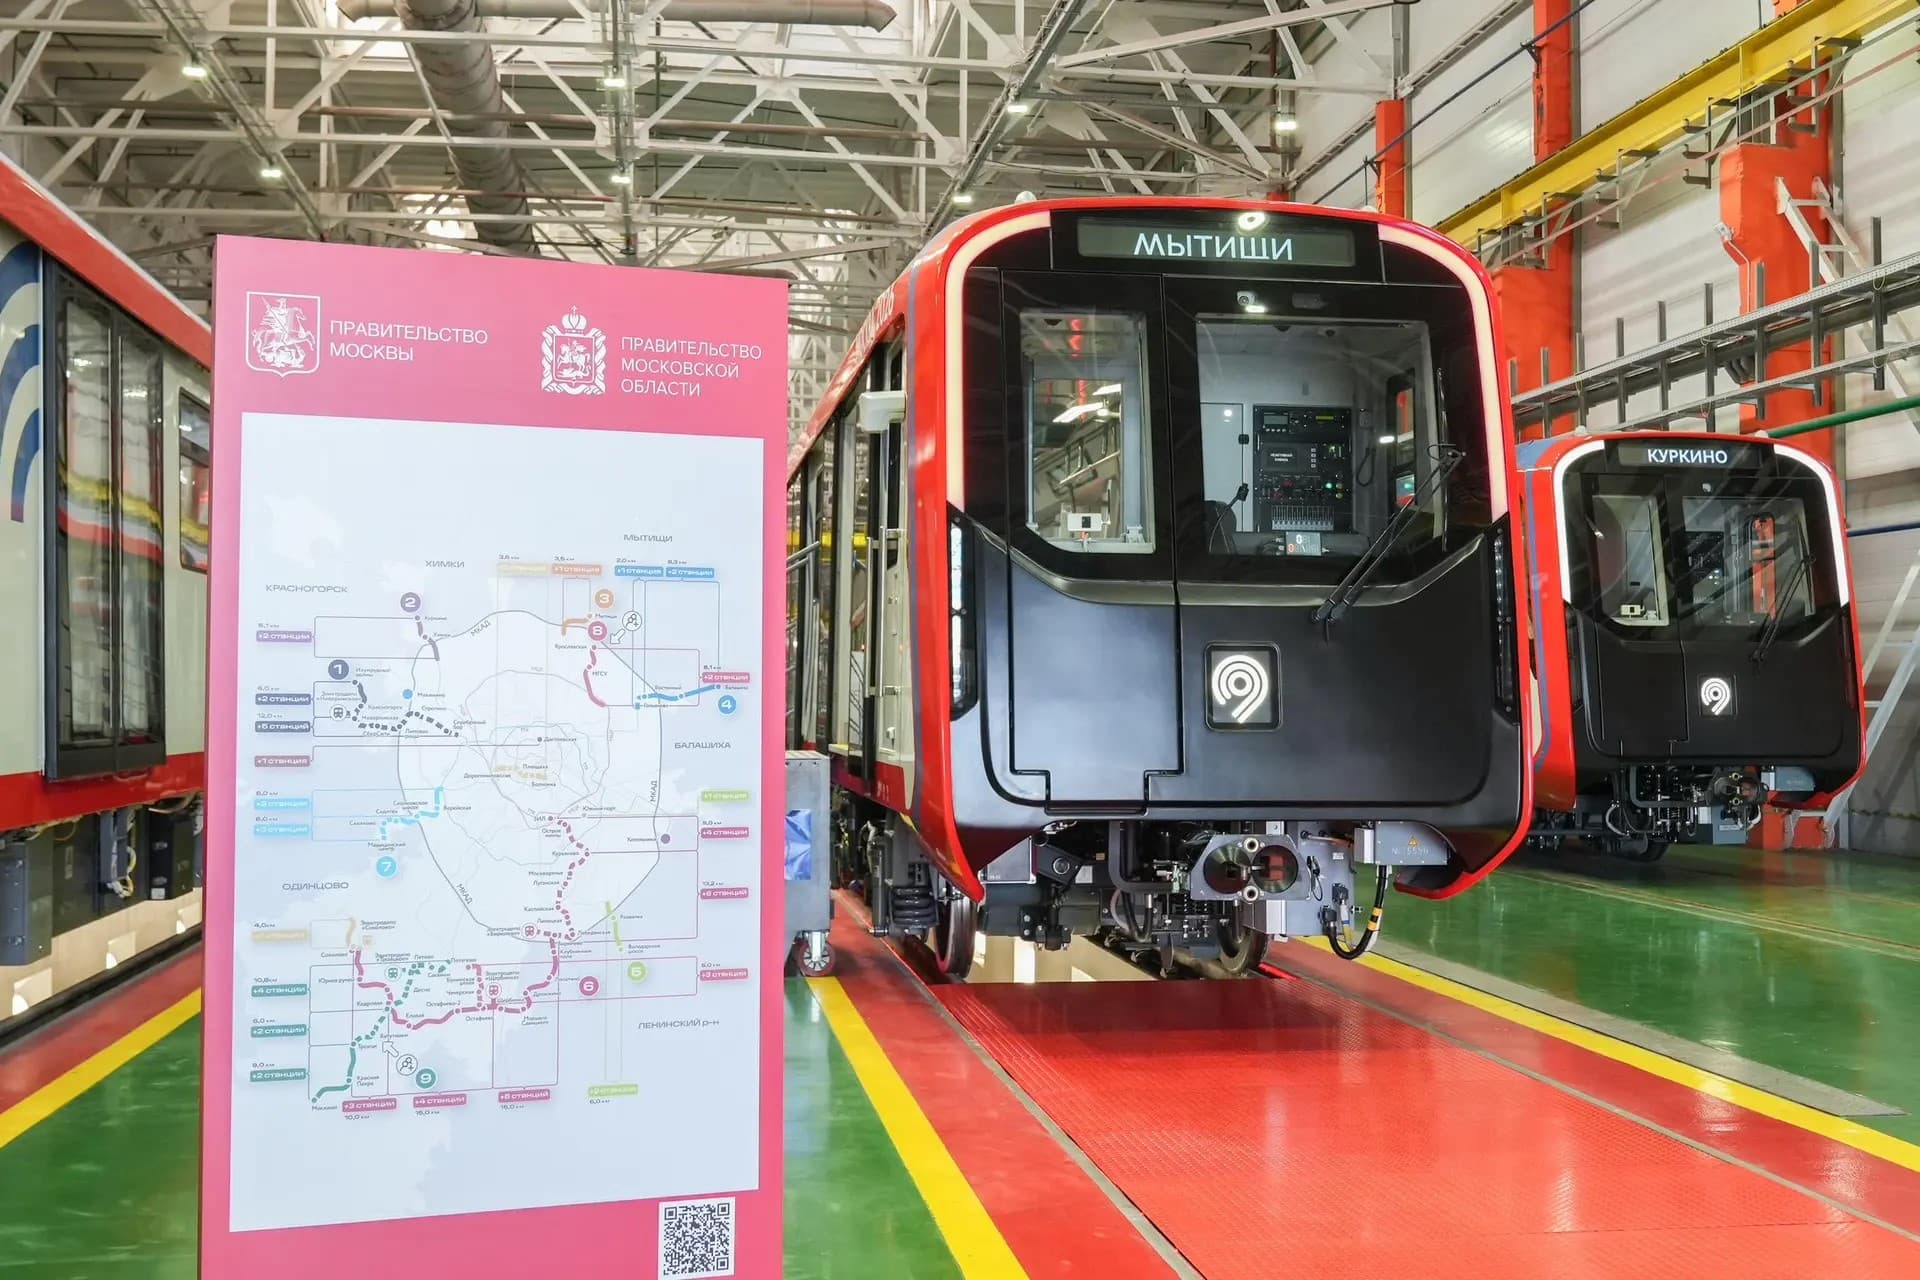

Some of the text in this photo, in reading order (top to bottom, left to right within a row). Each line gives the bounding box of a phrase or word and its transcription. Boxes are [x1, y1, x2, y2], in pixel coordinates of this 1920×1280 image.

[329, 320, 489, 344] ПРАВИТЕЛЬСТВО
[329, 342, 414, 361] МОСКВЫ
[621, 337, 762, 360] ПРАВИТЕЛЬСТВО
[621, 357, 740, 378] МОСКОВСКОЙ
[621, 378, 701, 397] ОБЛАСТИ
[1647, 448, 1728, 464] КУРКИНО
[623, 534, 673, 543] МЫТИЩИ
[425, 560, 465, 568] ХИМКИ
[265, 584, 348, 593] КРАСНОГОРСК
[282, 881, 349, 891] ОДИНЦОВО
[638, 1018, 701, 1030] ЛЕНИНСКИЙ
